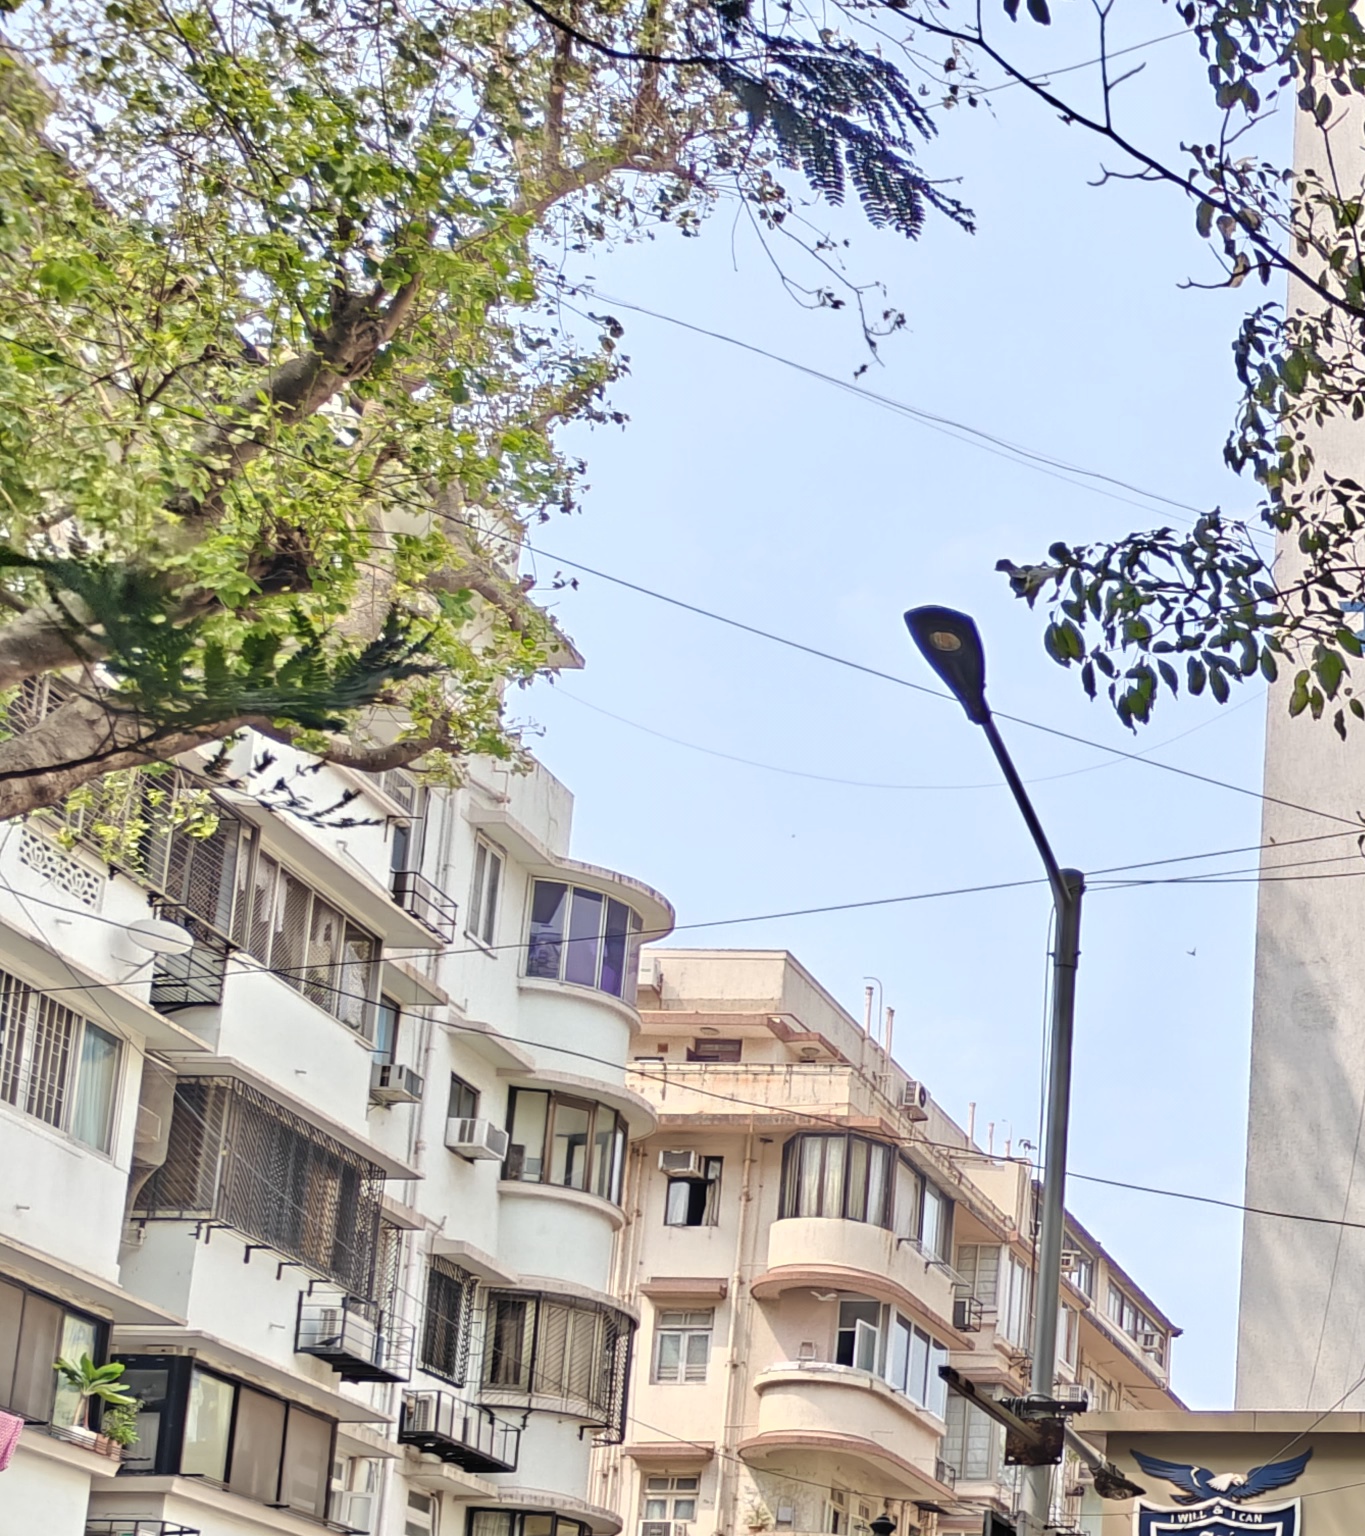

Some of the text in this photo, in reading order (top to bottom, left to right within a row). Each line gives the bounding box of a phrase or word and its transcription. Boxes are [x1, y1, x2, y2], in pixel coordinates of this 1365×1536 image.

[1177, 1510, 1207, 1524] WILL
[1212, 1505, 1224, 1515] &
[1239, 1512, 1263, 1523] CAN
